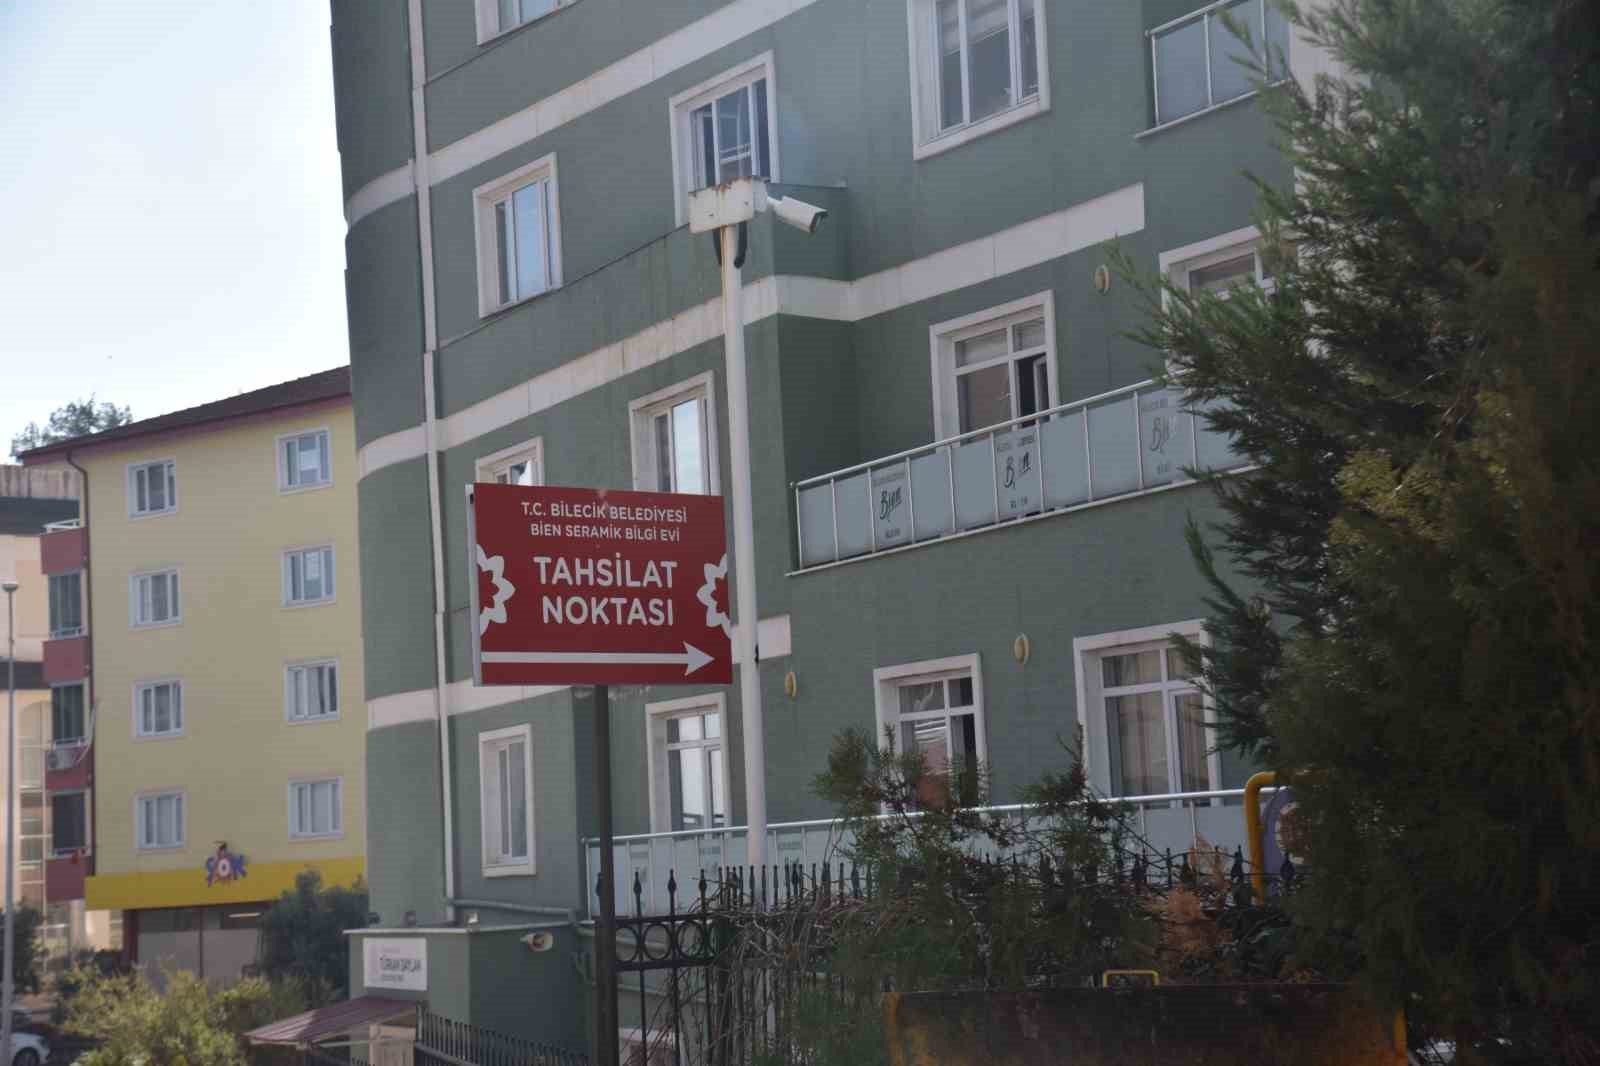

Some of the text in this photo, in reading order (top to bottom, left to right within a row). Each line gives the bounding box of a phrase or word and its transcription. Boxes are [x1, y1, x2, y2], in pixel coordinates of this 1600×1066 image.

[521, 501, 688, 523] T.C. BİLECİK BELEDİYESİ
[530, 520, 680, 542] BİEN SERAMİK BİLGİ EVİ
[533, 552, 678, 588] TAHSİLAT
[542, 596, 673, 626] NOKTASI
